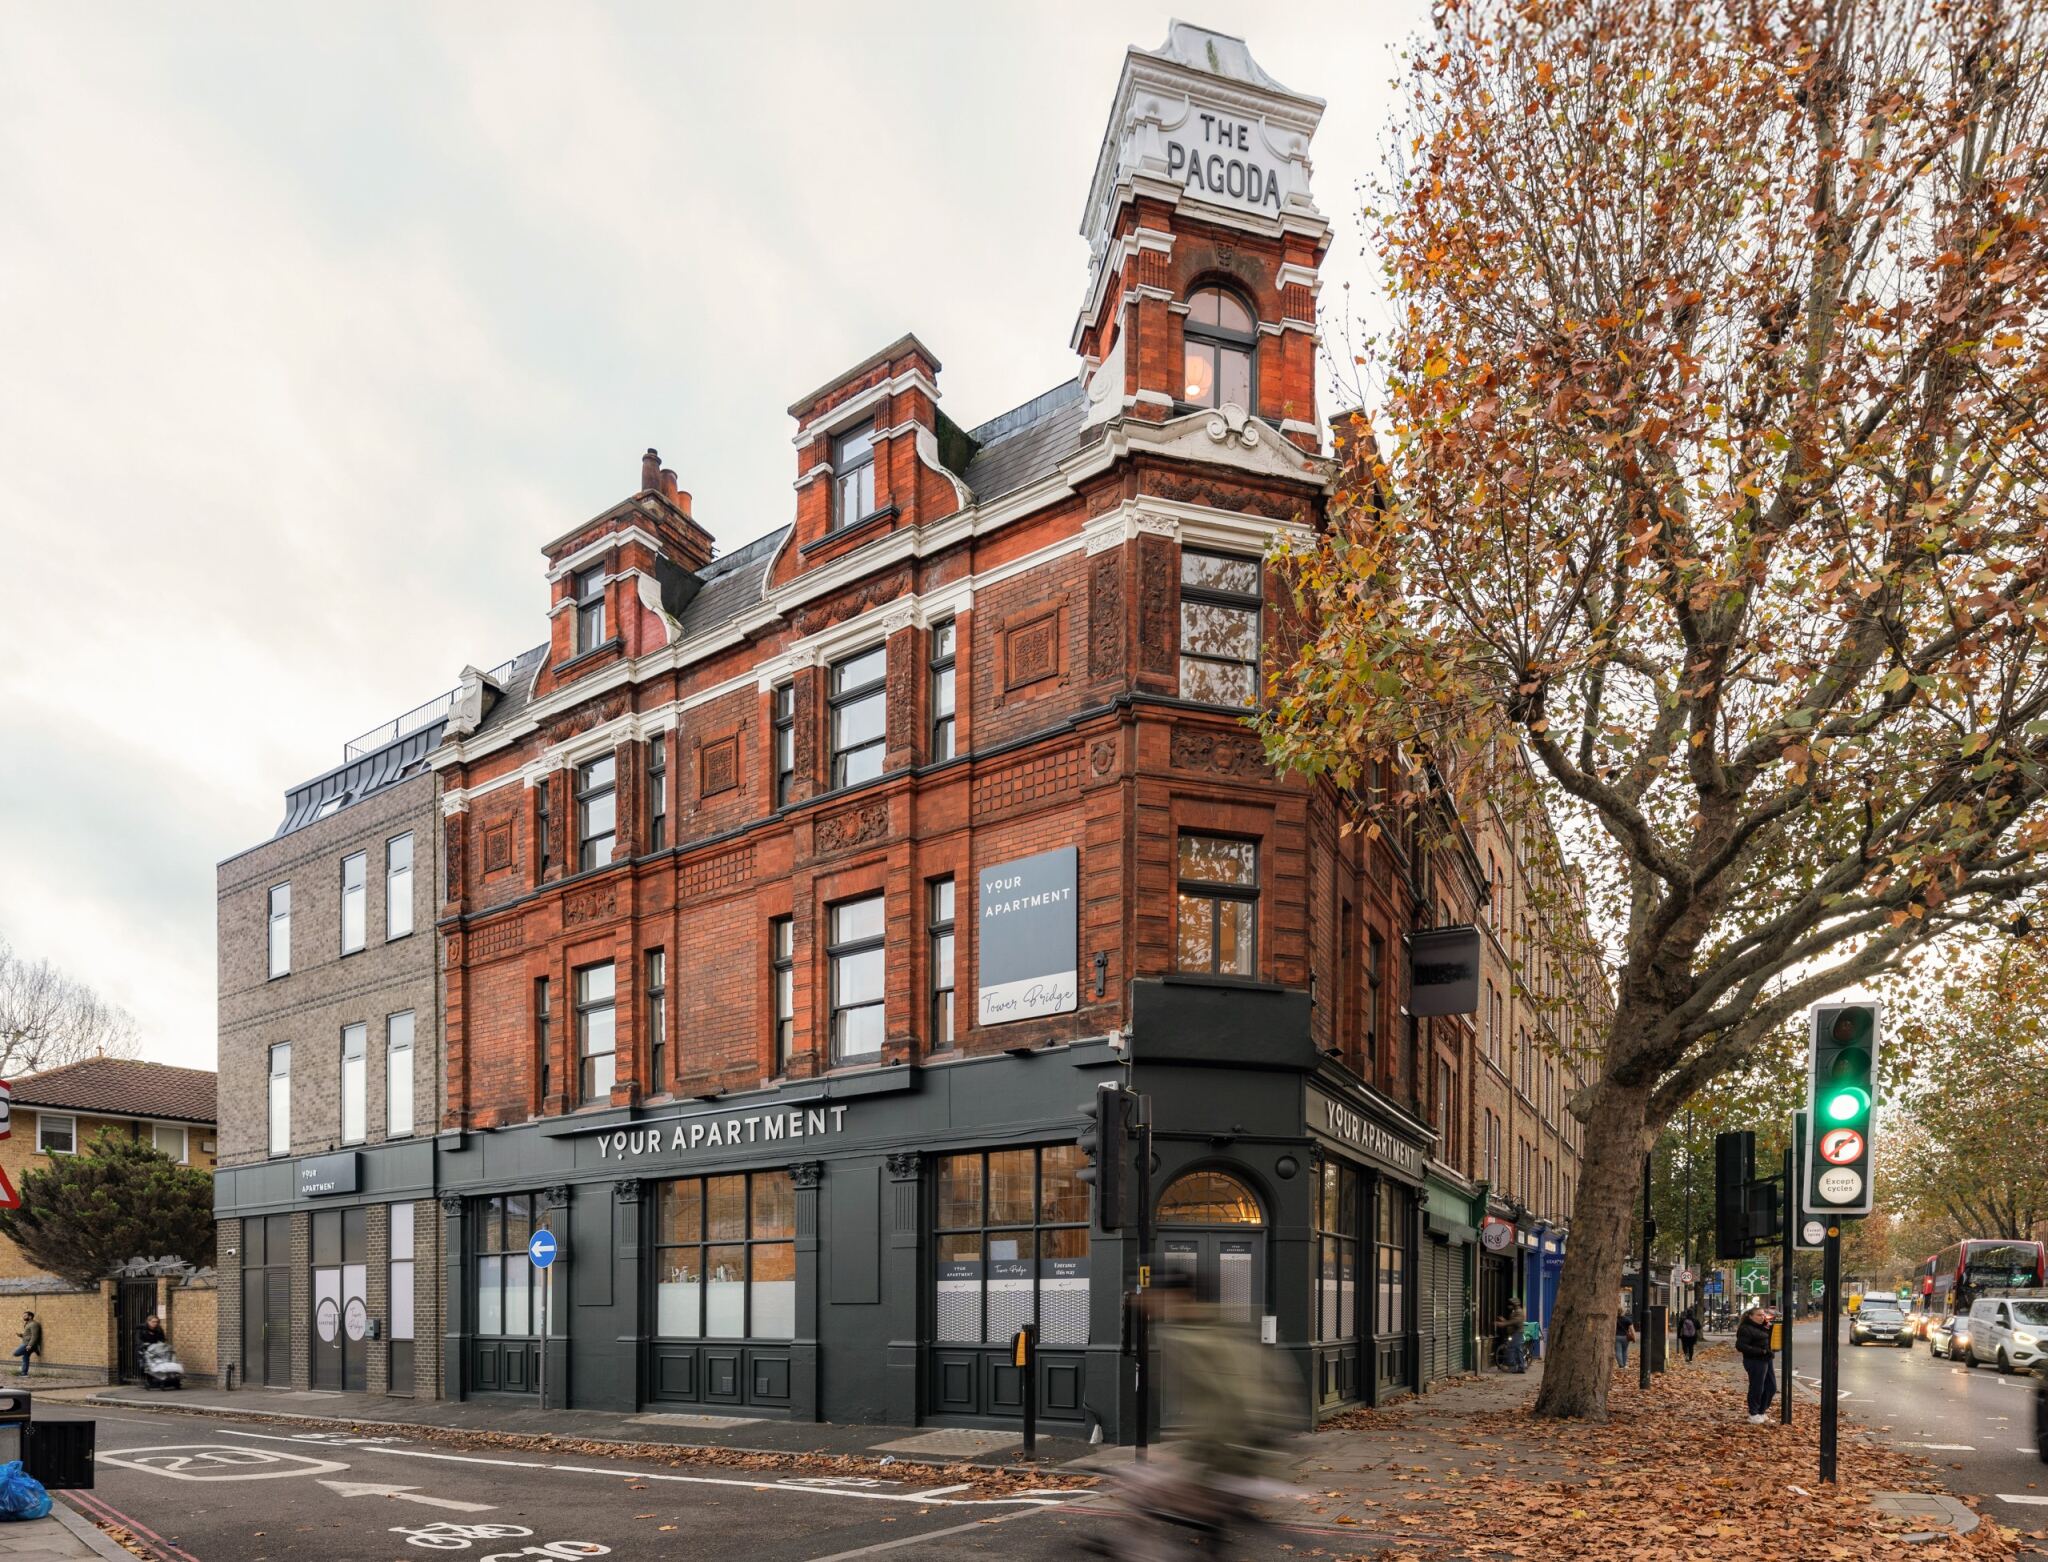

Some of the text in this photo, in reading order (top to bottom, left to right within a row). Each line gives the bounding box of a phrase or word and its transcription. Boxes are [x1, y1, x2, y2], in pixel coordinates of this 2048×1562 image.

[1200, 113, 1249, 152] THE
[1167, 140, 1281, 210] PAGODA
[985, 876, 1022, 894] YOUR
[985, 888, 1070, 918] APARTMENT
[981, 984, 1074, 1014] Tower Bridge
[597, 1105, 848, 1160] YOUR APARTMENT
[1327, 1100, 1415, 1169] YOUR APARTMENT
[302, 1169, 317, 1180] YOUR
[302, 1182, 335, 1192] APARTMENT
[134, 1451, 281, 1471] 20
